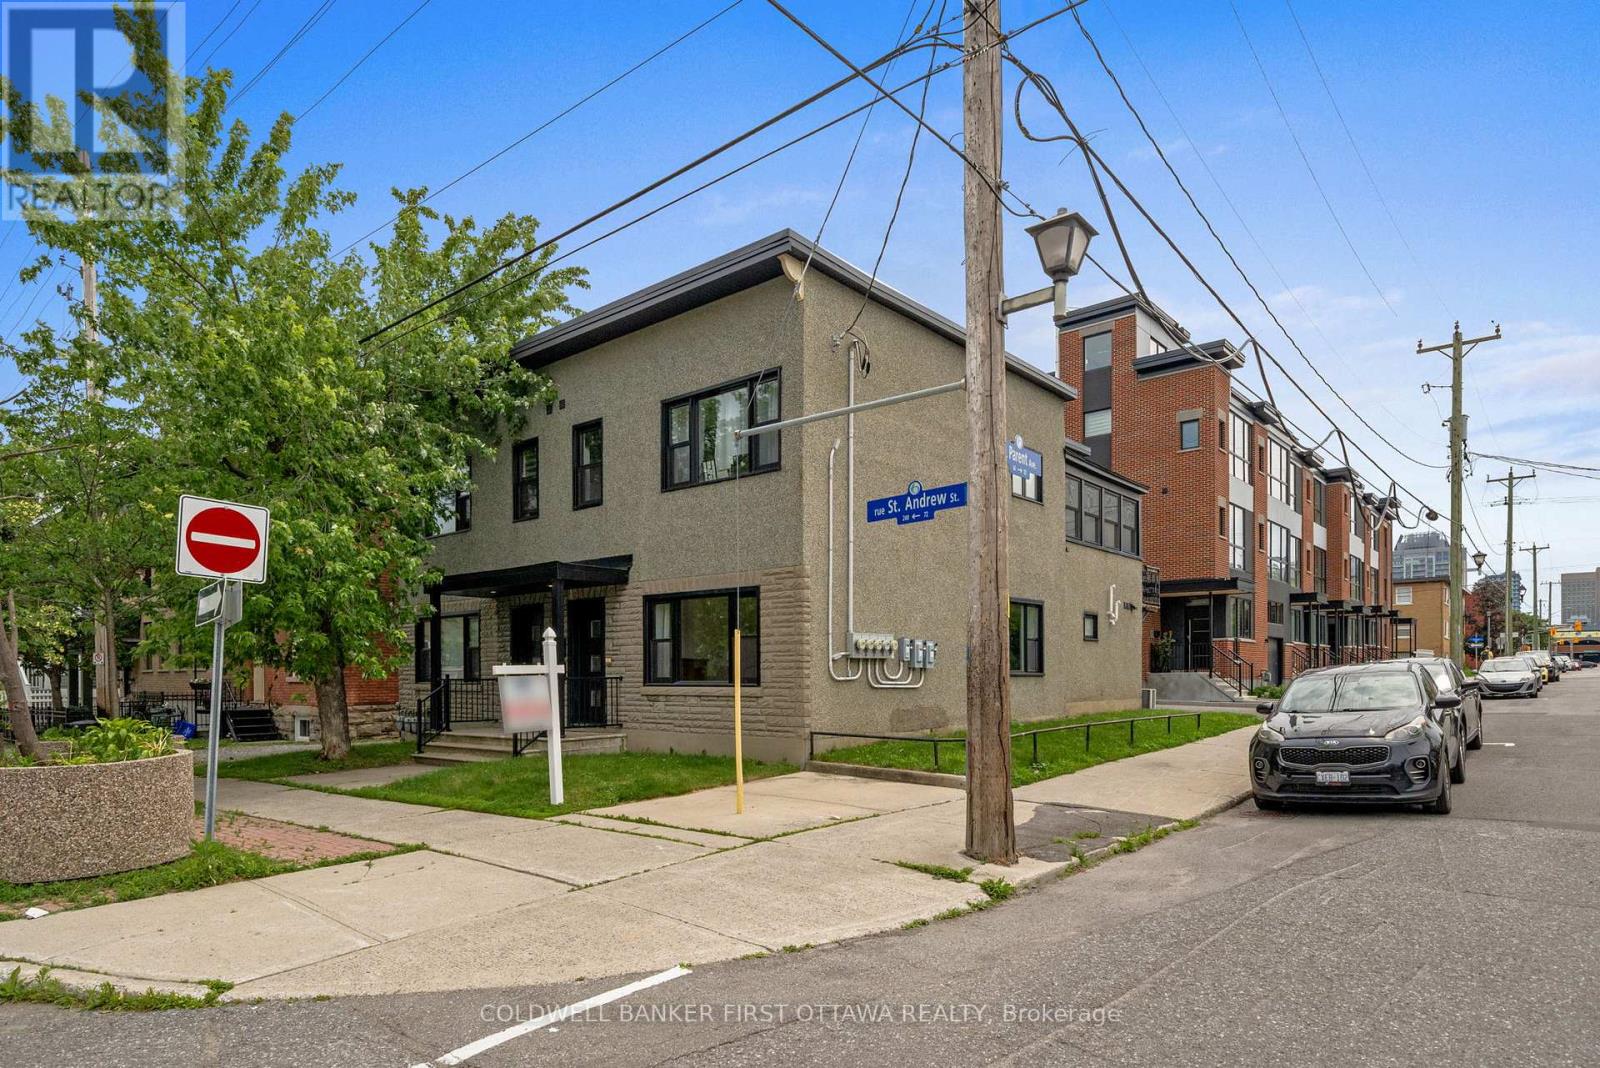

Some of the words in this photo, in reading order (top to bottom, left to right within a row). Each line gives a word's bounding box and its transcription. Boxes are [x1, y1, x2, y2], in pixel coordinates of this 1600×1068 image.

[1008, 444, 1028, 466] Parent
[874, 508, 885, 517] rue
[887, 499, 901, 514] St.
[904, 492, 947, 511] Andrew
[949, 492, 960, 503] St.
